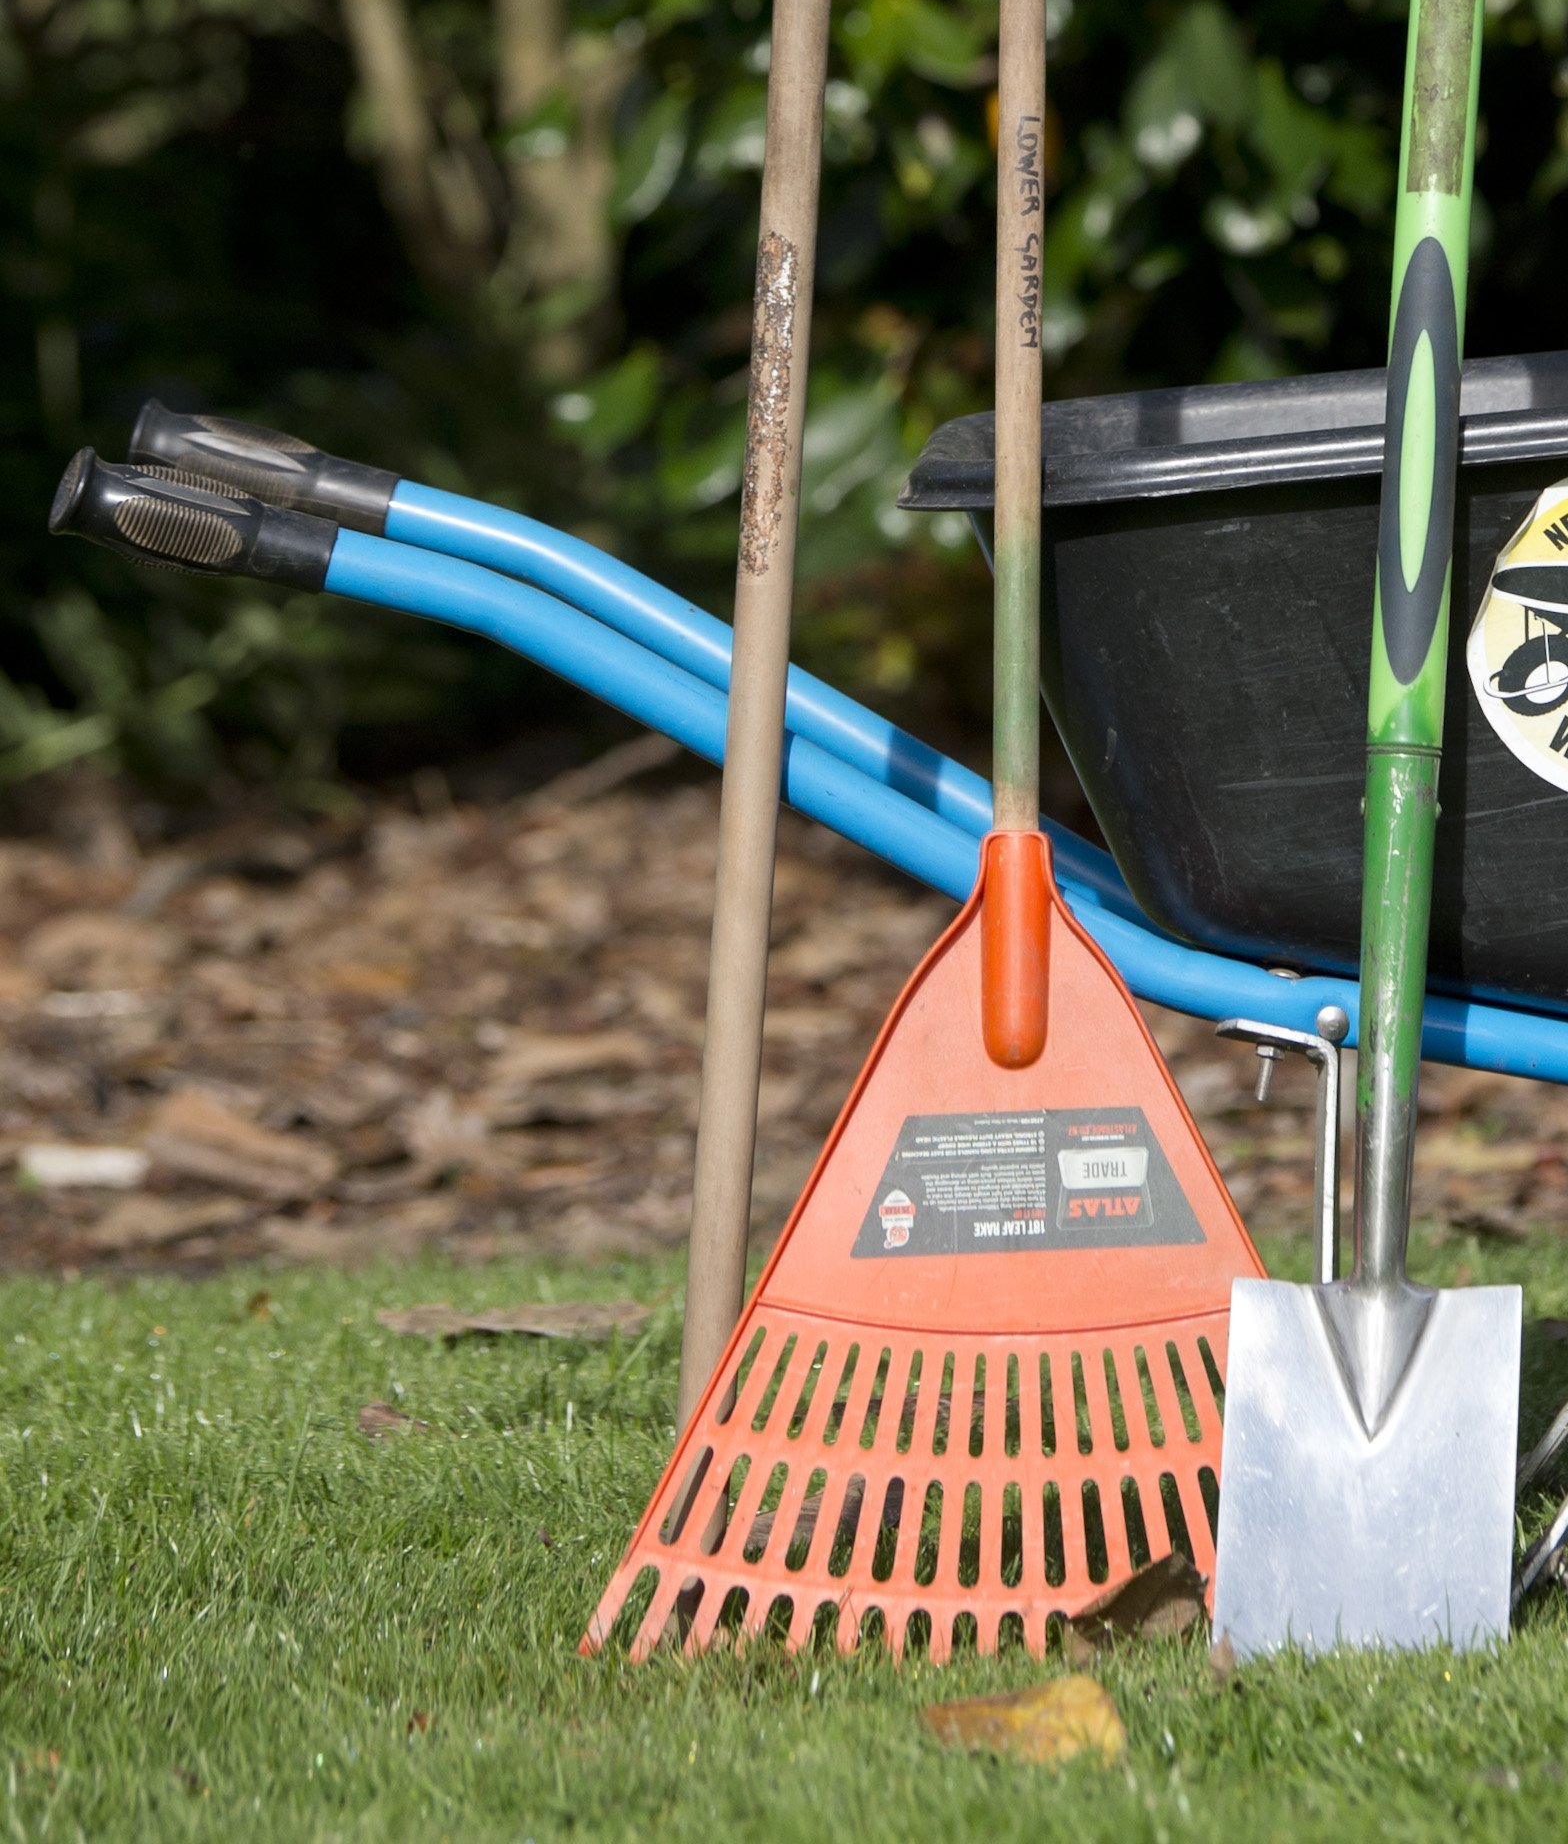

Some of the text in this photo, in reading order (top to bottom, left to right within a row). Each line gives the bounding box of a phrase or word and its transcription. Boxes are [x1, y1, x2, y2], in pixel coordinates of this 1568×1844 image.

[1014, 115, 1041, 348] LOWER GARDEN
[1083, 1161, 1128, 1179] TRADE
[1068, 1197, 1140, 1218] ATLAS
[974, 1221, 1001, 1237] RAKE
[1001, 1220, 1027, 1236] LEAF
